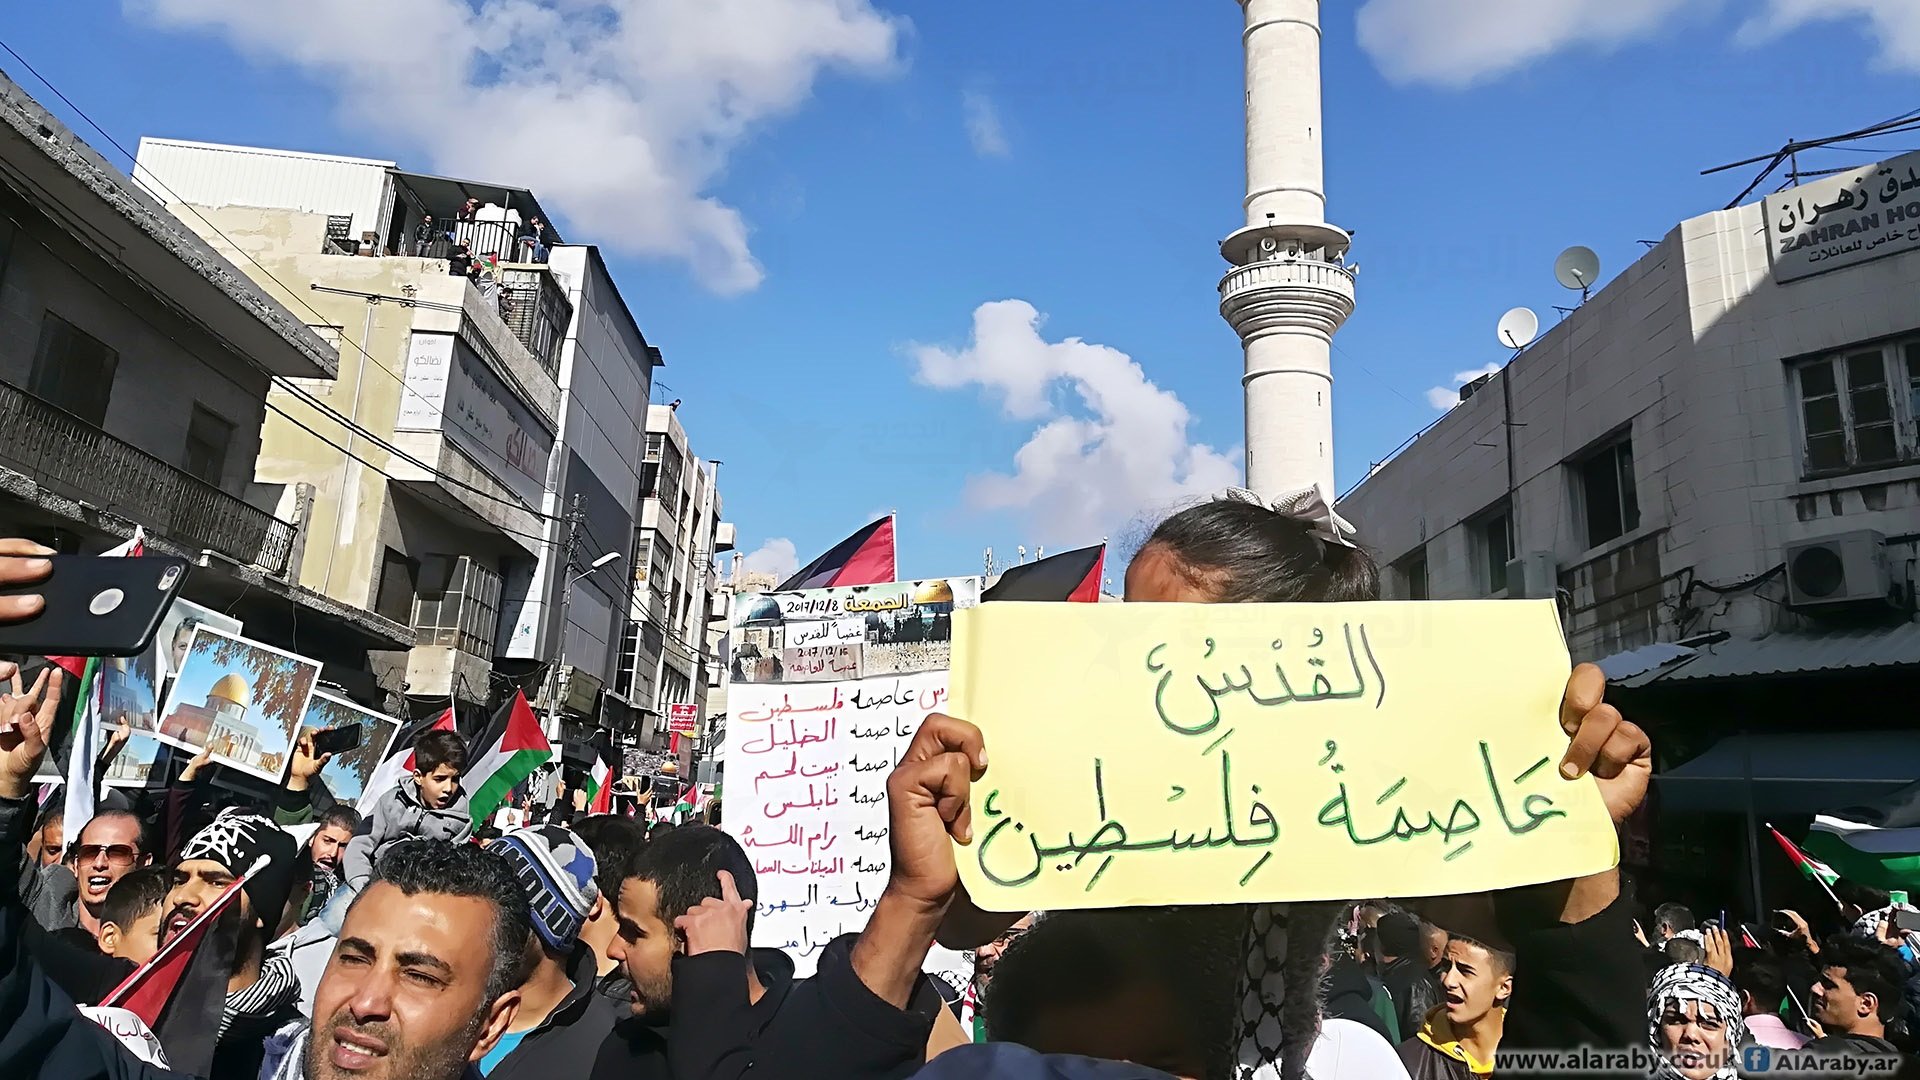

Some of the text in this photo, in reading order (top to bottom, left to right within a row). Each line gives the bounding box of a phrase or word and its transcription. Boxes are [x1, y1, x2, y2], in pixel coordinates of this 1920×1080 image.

[1779, 177, 1869, 233] زهران
[1780, 213, 1880, 253] ZAHRAN
[1866, 229, 1904, 250] خاص
[787, 593, 909, 614] الجمعة 2017/12/8
[793, 622, 829, 646] للقدس
[739, 687, 844, 722] فلسطين
[741, 717, 836, 754] الخليل
[754, 751, 797, 796] لحم
[800, 761, 839, 779] بيت
[763, 783, 839, 818] نابلس
[808, 821, 838, 860] رام
